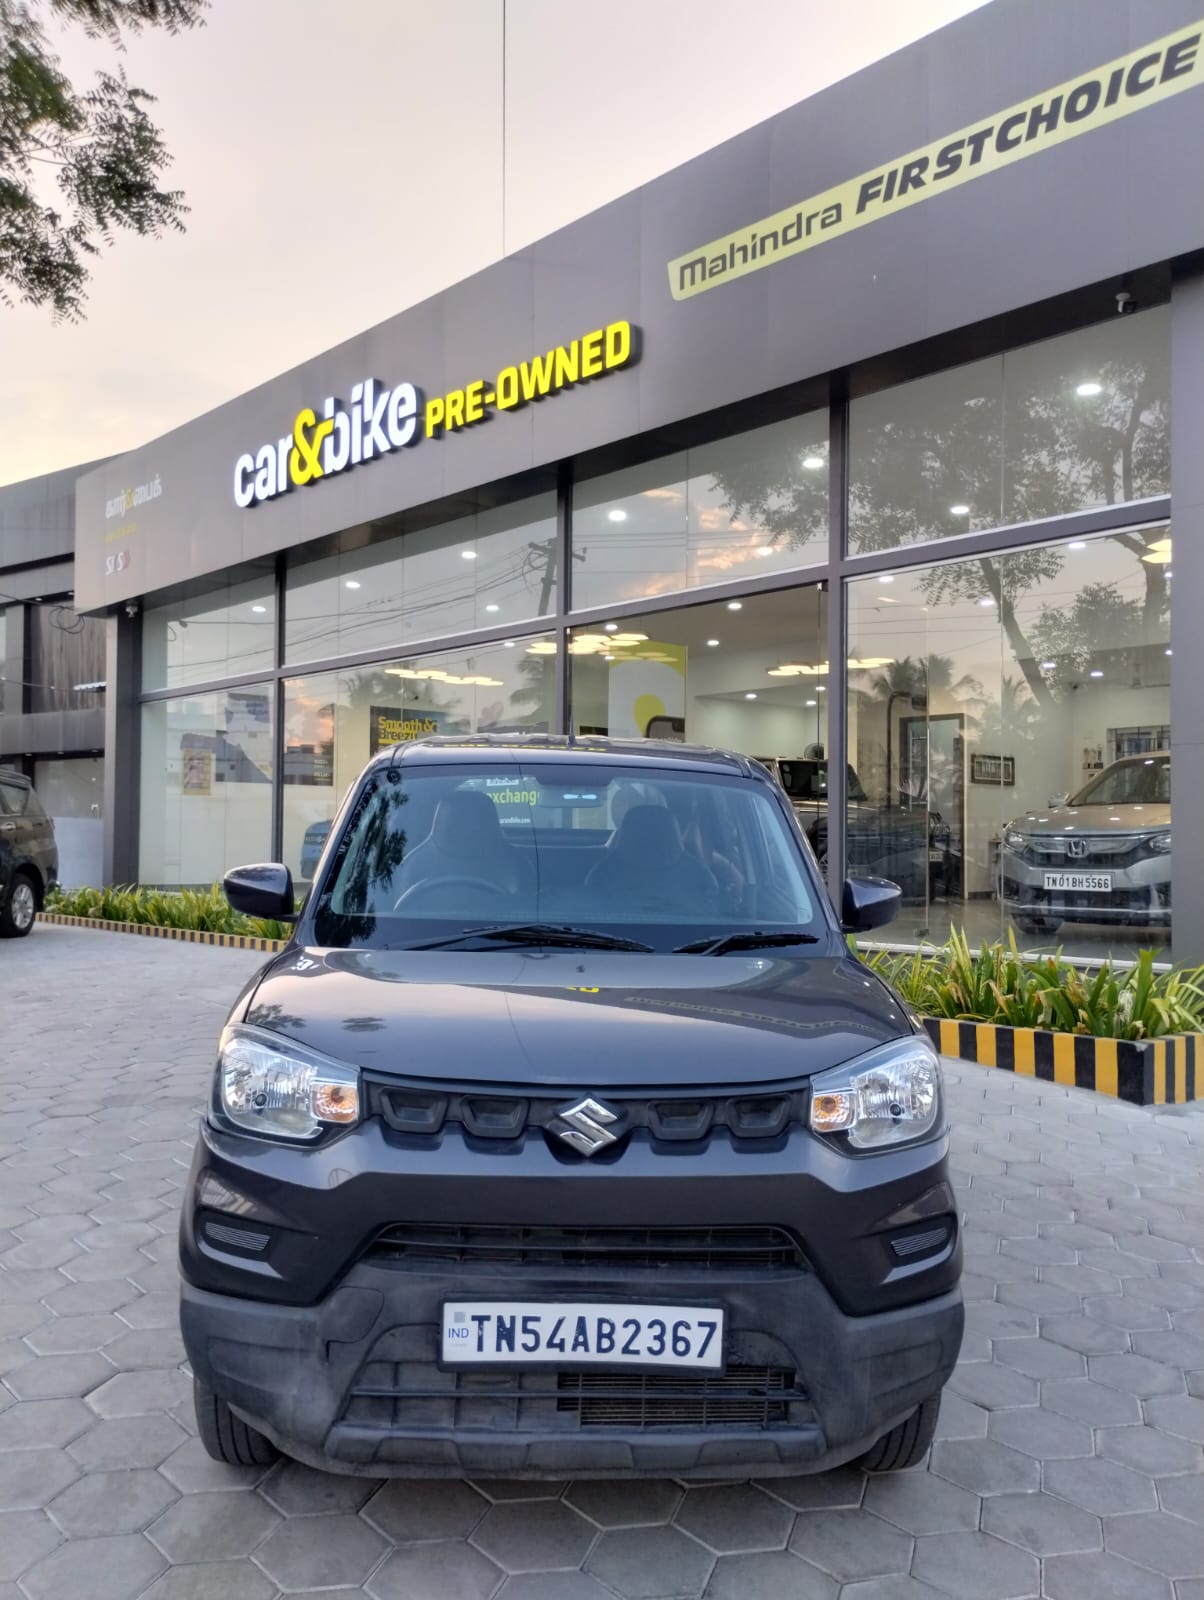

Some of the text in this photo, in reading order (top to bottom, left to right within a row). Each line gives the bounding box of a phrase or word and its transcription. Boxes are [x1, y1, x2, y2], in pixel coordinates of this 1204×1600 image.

[679, 203, 842, 291] Mahindra
[233, 320, 632, 508] car&bike PRE-OWNED
[378, 716, 422, 732] Smooth
[486, 788, 541, 806] xchang
[448, 1314, 718, 1359] IND TN54AB2367
